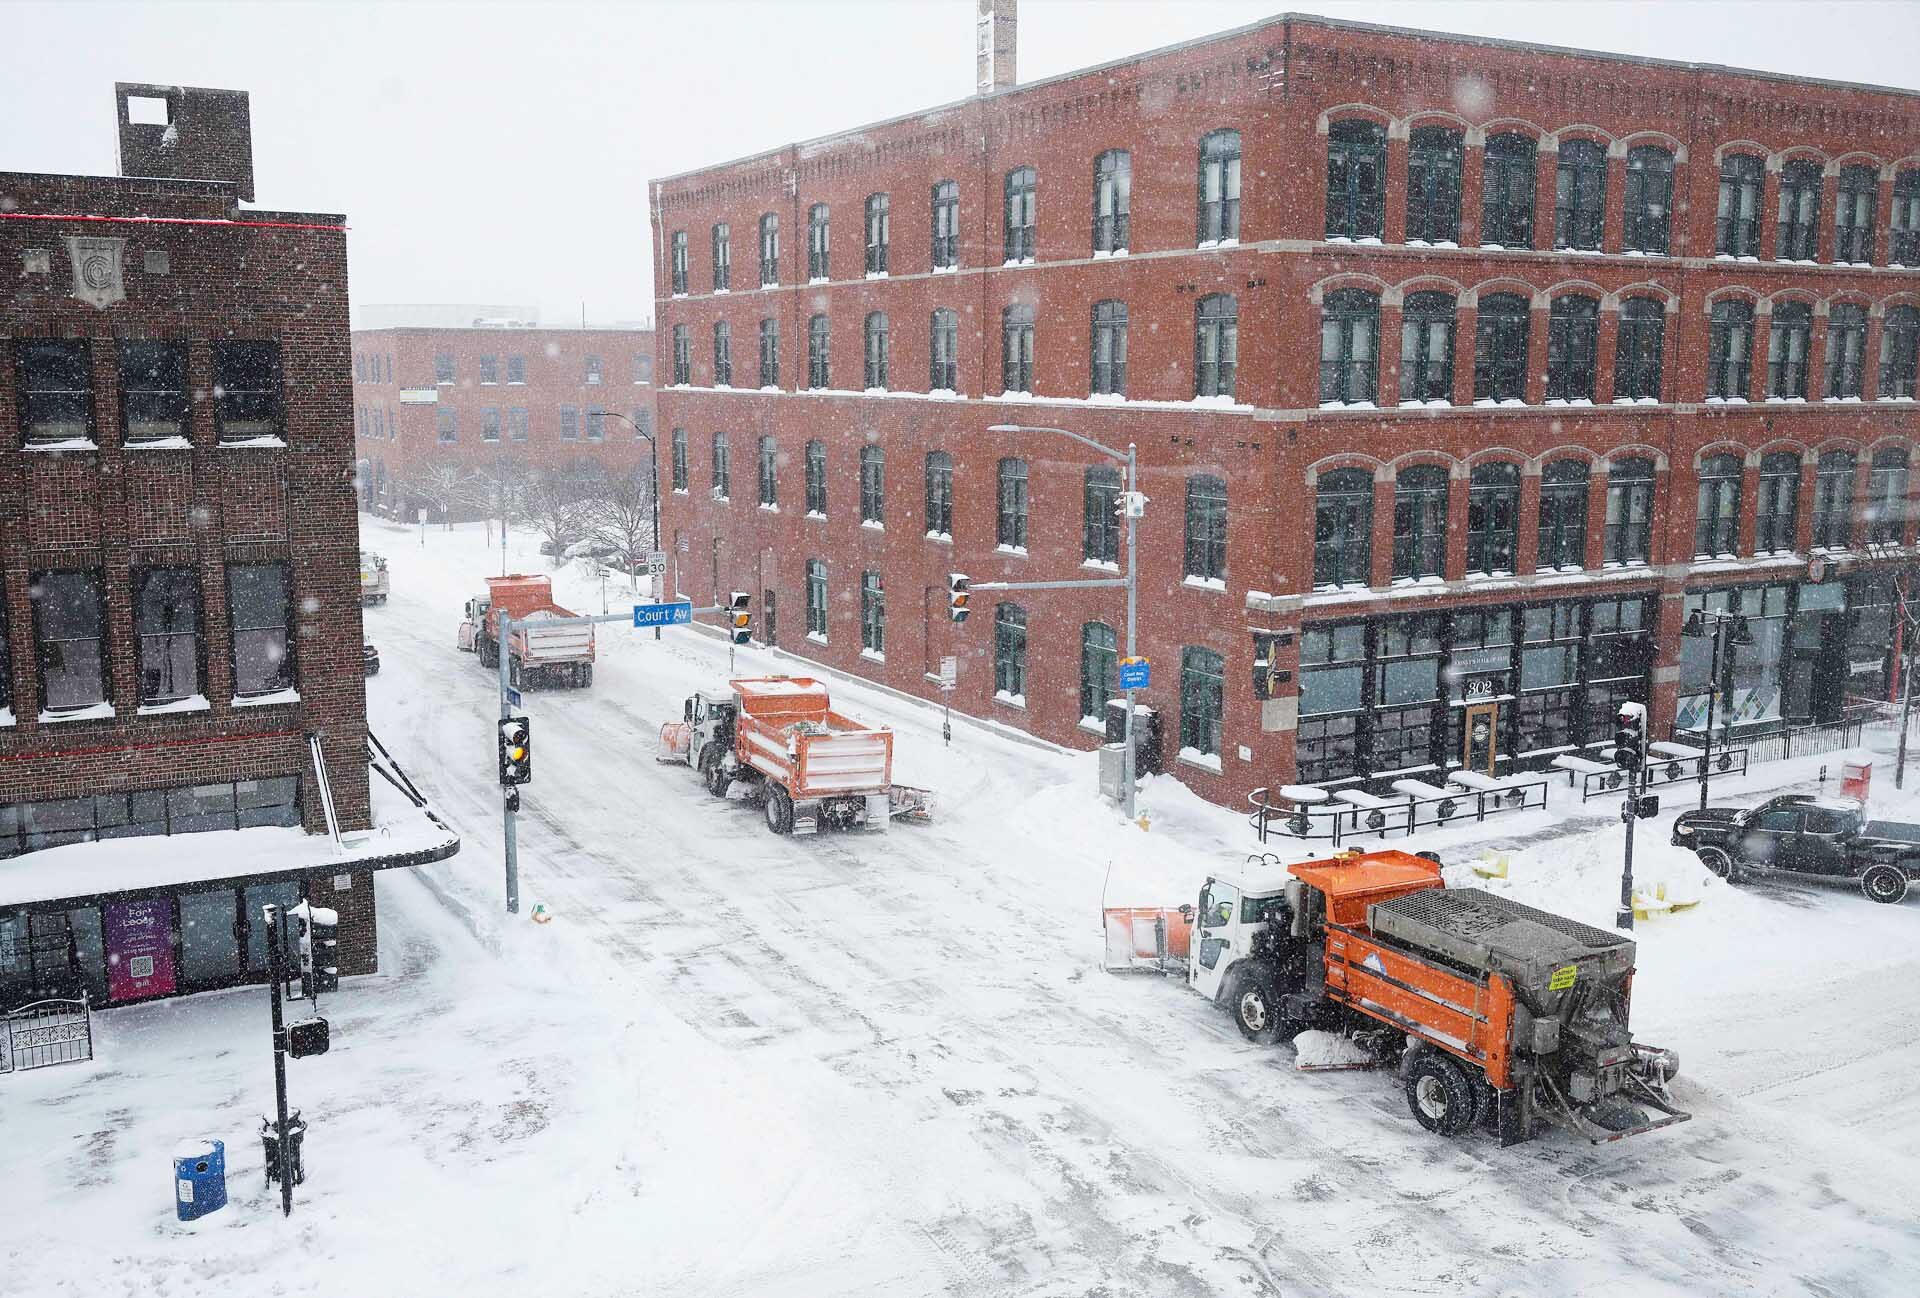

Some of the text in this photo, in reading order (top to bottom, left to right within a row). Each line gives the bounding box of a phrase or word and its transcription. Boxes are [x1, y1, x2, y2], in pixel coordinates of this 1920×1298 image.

[651, 563, 665, 573] 30
[637, 608, 688, 622] Court Av
[1469, 680, 1492, 695] 302
[129, 908, 148, 918] For
